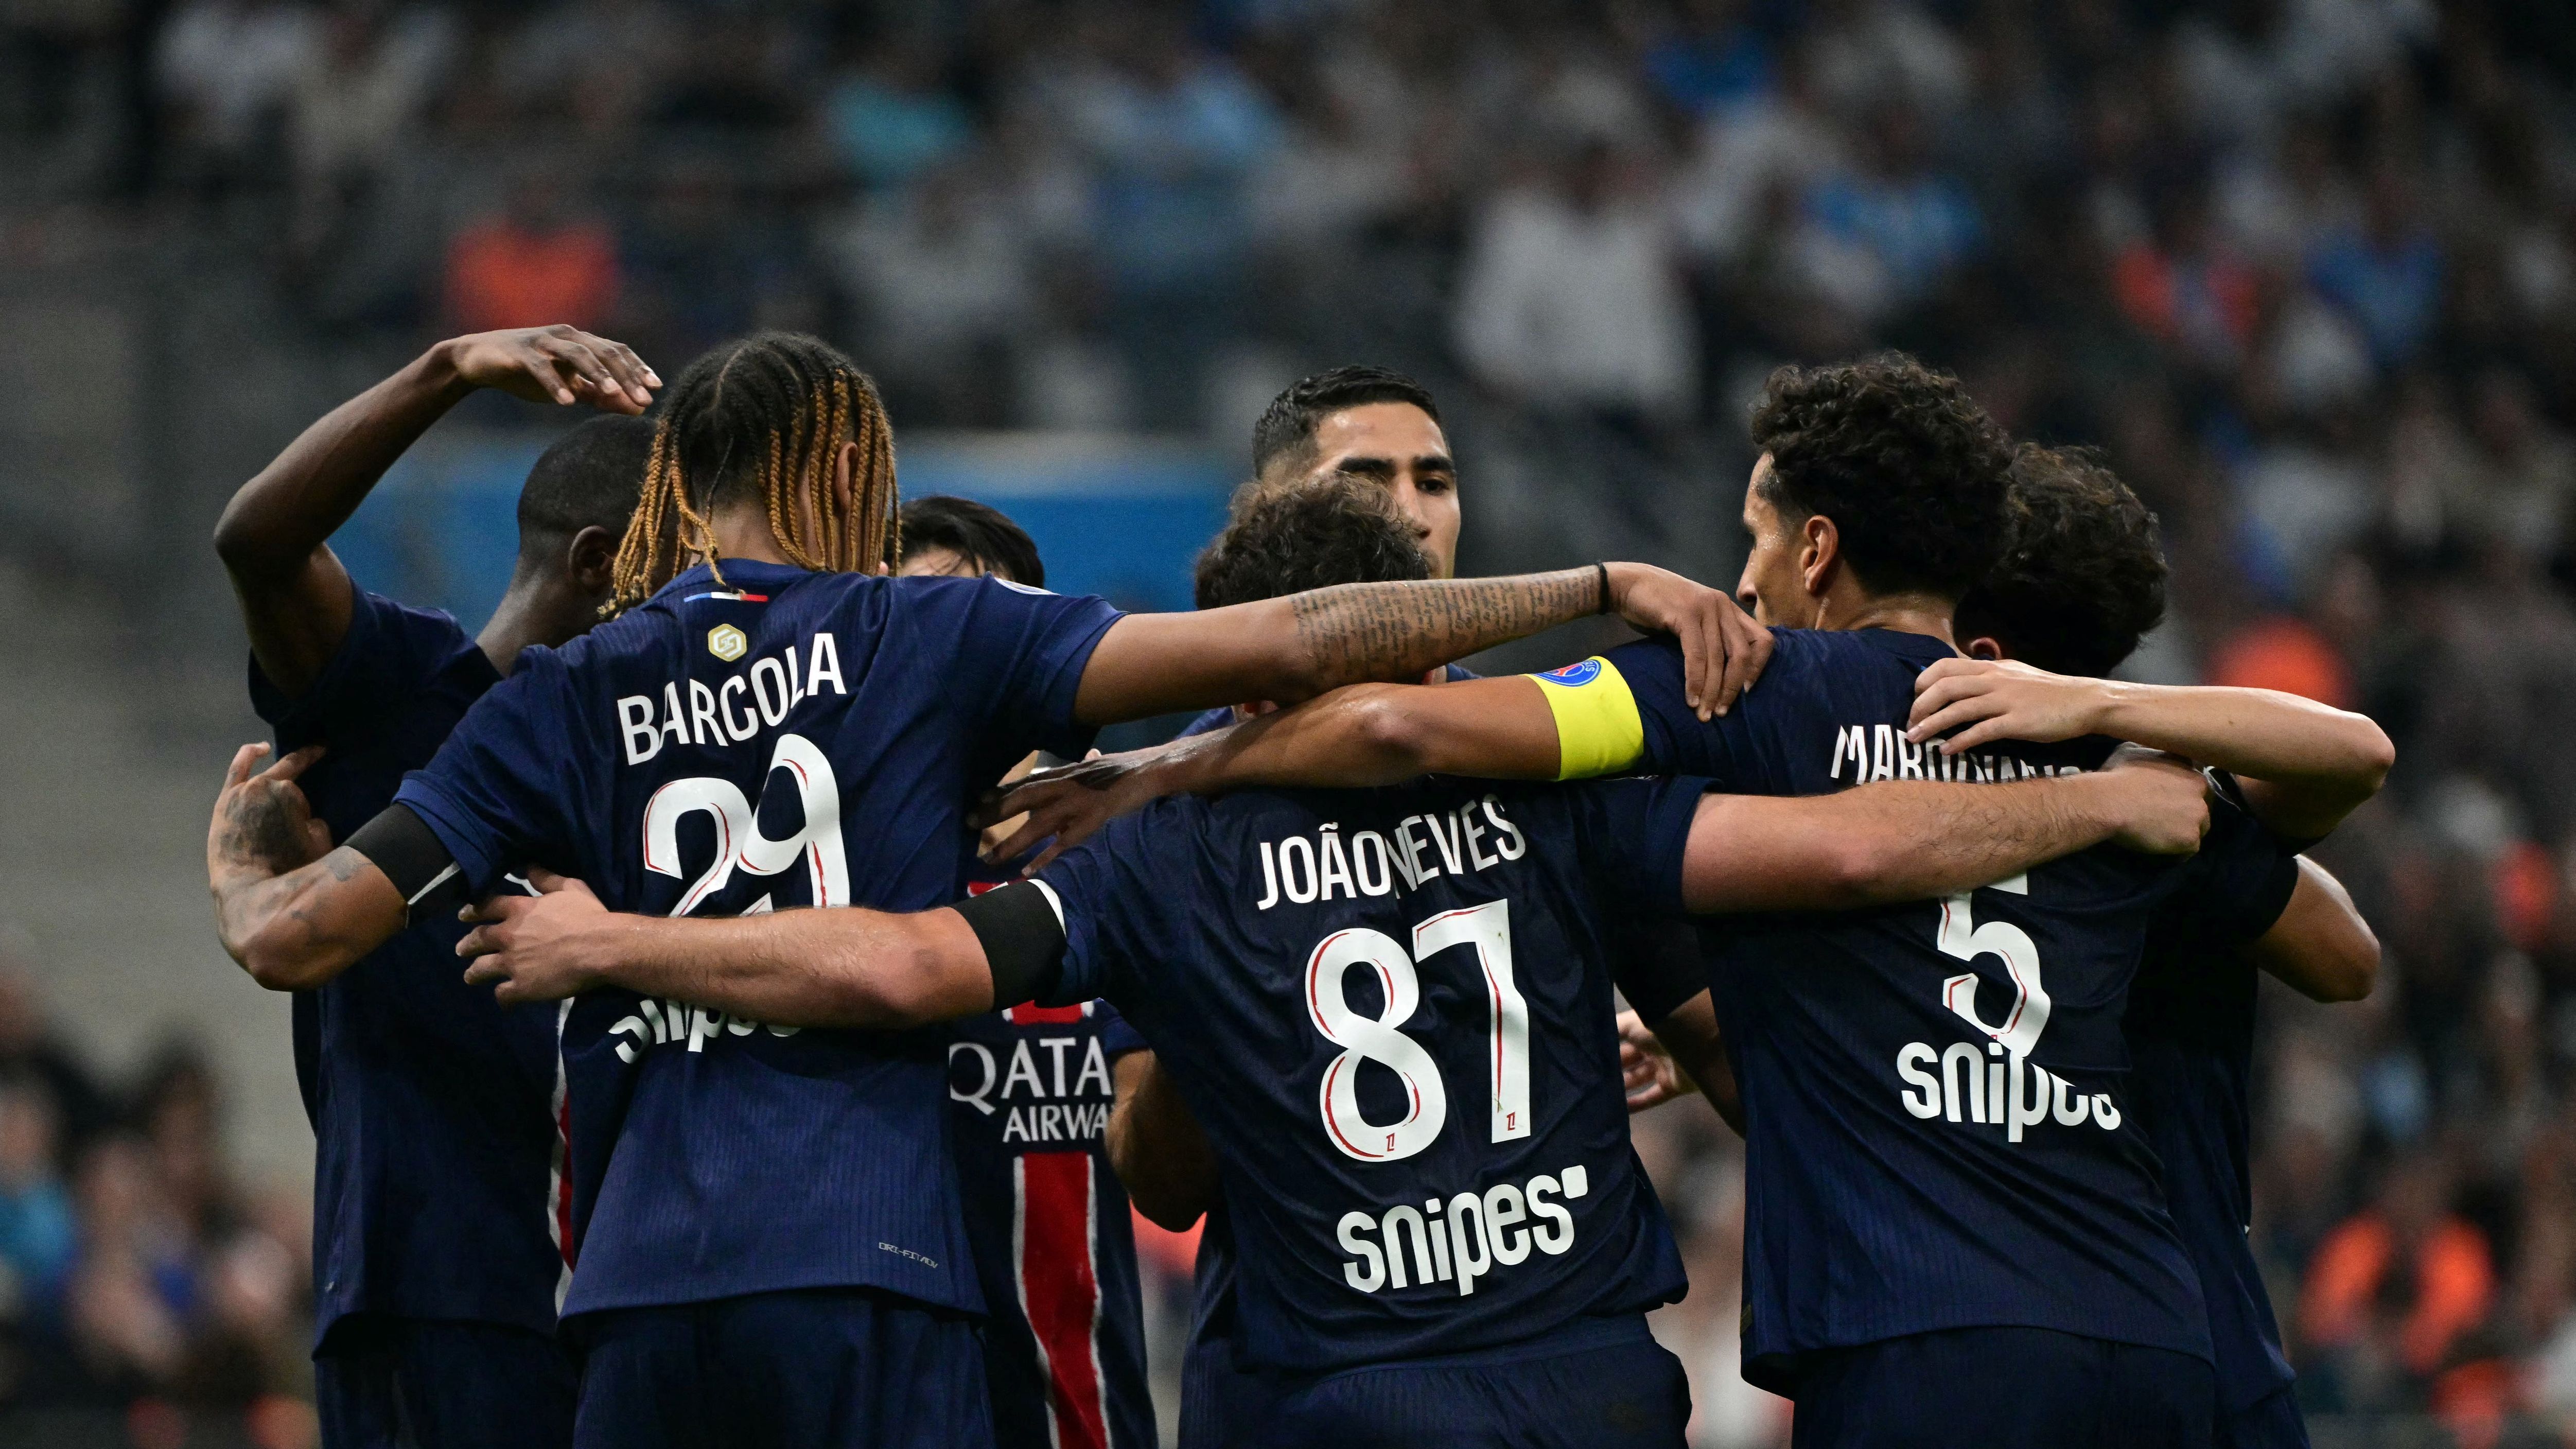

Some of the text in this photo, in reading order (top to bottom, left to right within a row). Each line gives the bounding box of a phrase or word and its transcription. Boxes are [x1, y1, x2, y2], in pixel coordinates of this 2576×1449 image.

[618, 633, 847, 766] BARCOLA
[642, 734, 850, 917] 29
[1257, 794, 1526, 910] JOÃO NEVES
[1937, 873, 2051, 1058] 5
[949, 1035, 1113, 1116] QATA
[1305, 898, 1531, 1162] 87
[1002, 1103, 1115, 1143] AIRWA
[1337, 1175, 1575, 1296] snipes
